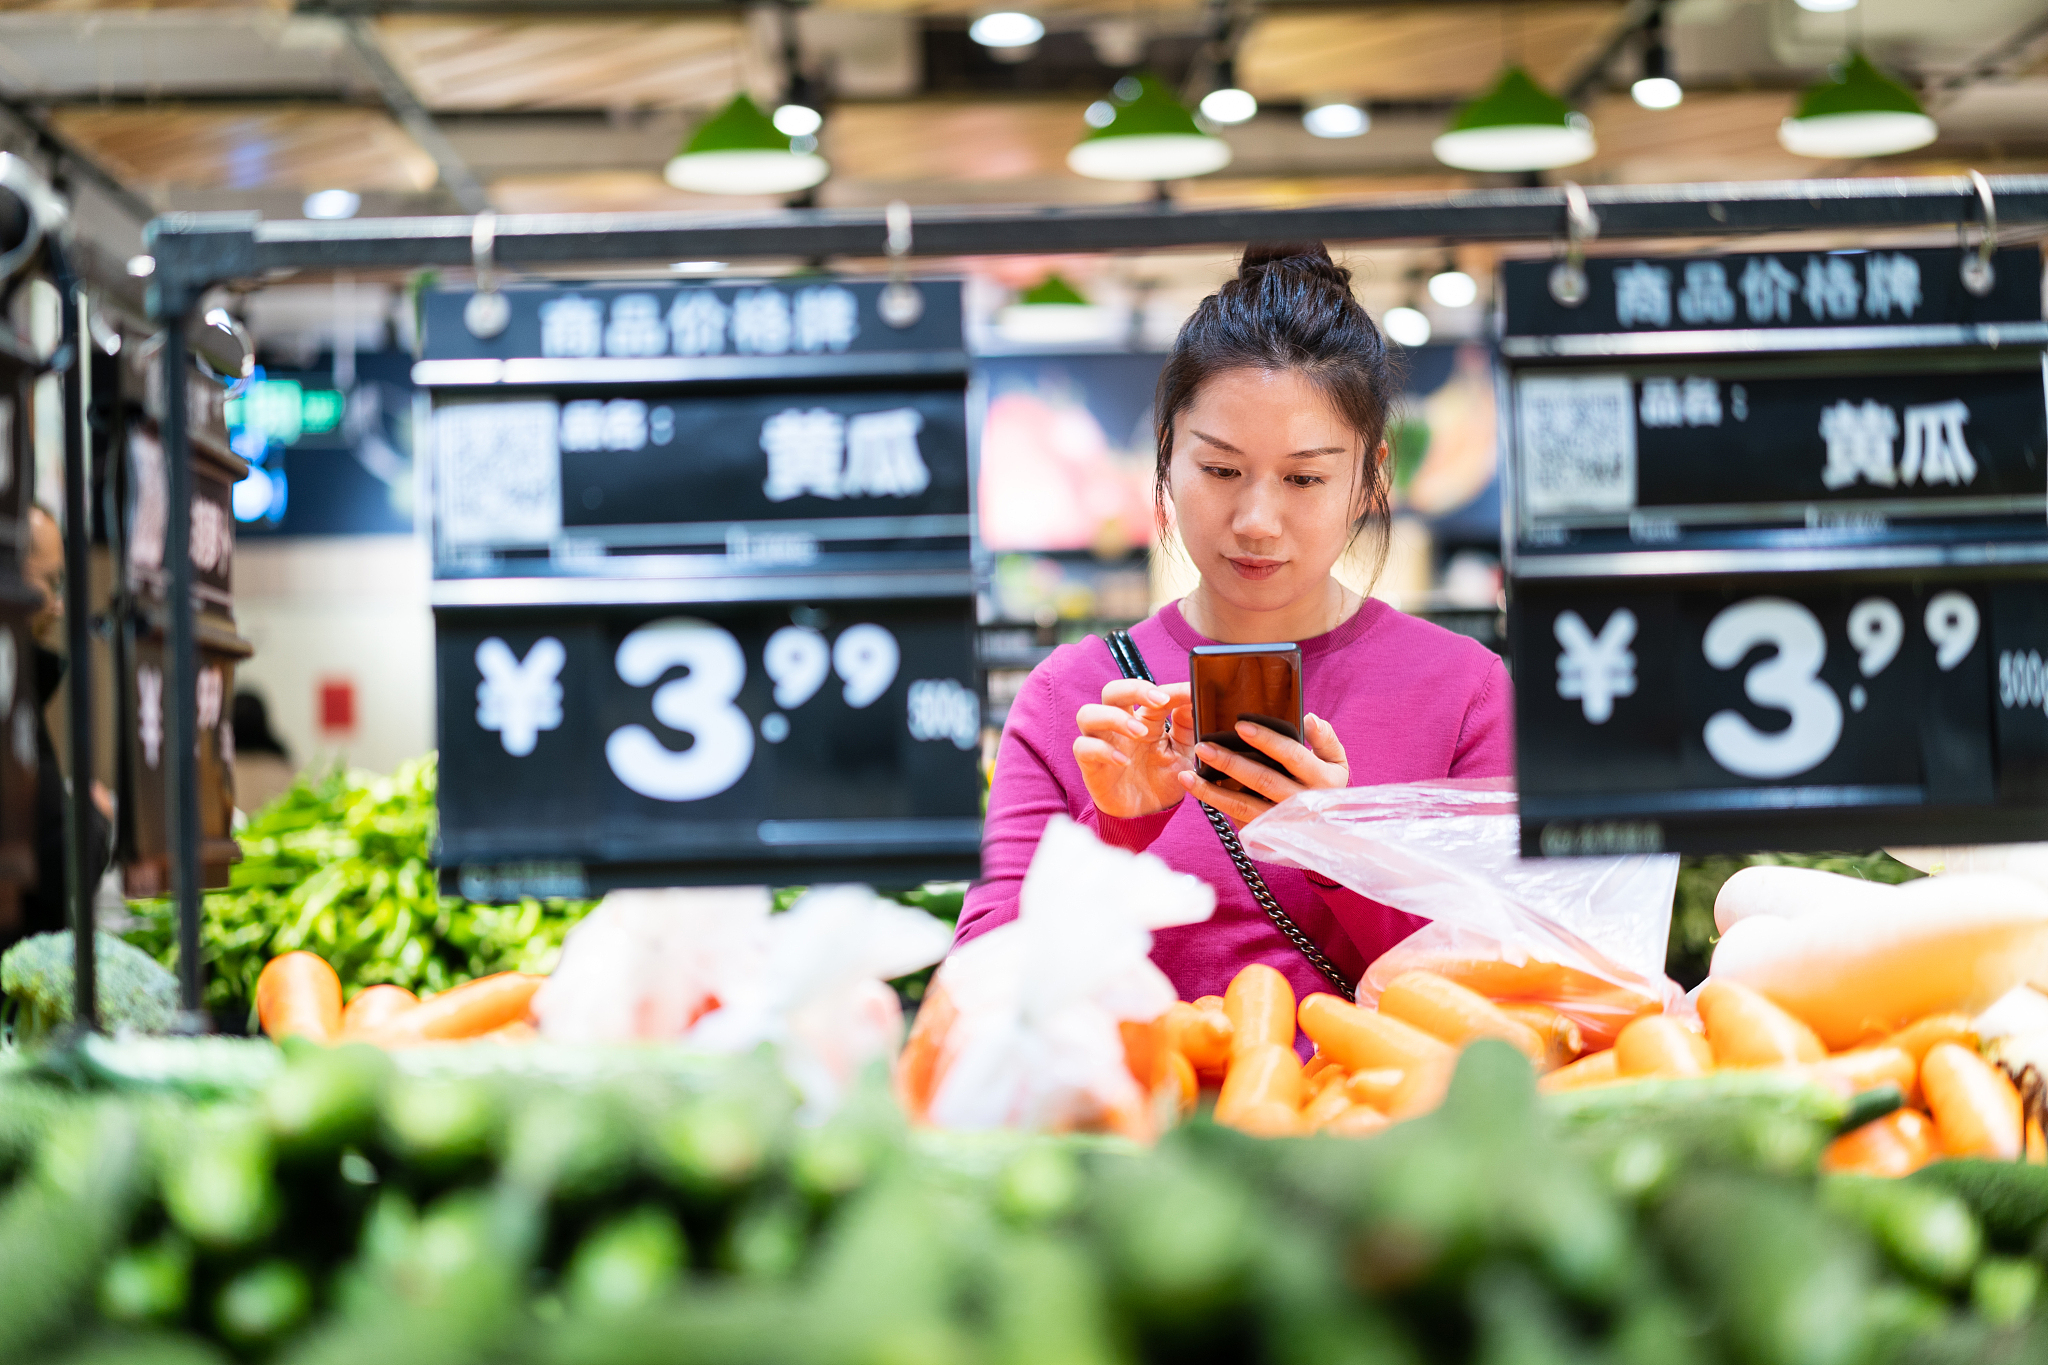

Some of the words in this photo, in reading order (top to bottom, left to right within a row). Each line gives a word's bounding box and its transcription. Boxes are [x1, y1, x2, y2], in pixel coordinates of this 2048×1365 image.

[541, 286, 858, 358] 商品价格牌
[1613, 251, 1923, 328] 商品价格牌
[760, 407, 931, 501] 黄瓜
[1818, 398, 1978, 491] 黄瓜
[1999, 647, 2048, 719] 500
